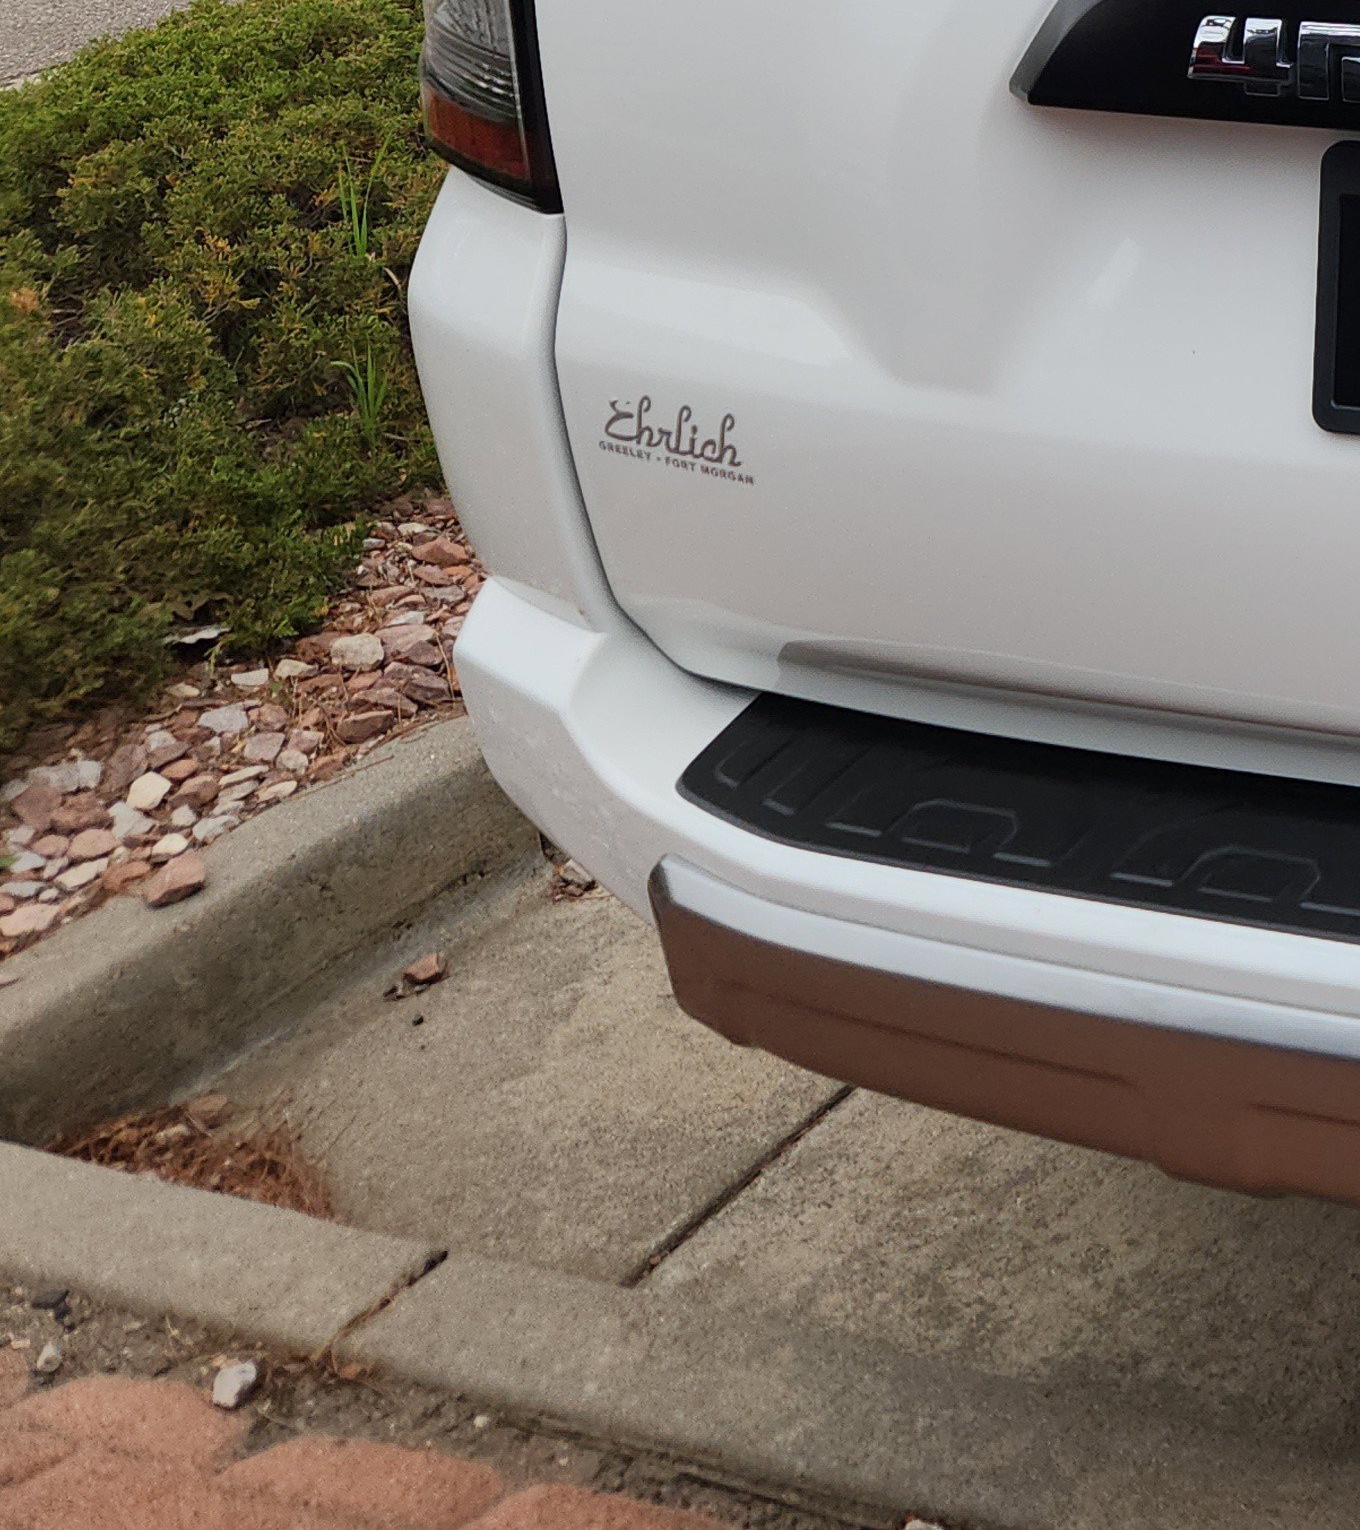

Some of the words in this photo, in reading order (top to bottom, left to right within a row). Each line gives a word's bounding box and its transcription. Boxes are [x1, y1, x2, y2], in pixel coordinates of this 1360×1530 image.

[605, 395, 741, 467] Ehrlich
[599, 440, 652, 461] GREELEY
[665, 456, 696, 472] FORT
[701, 465, 754, 485] MORGAN
